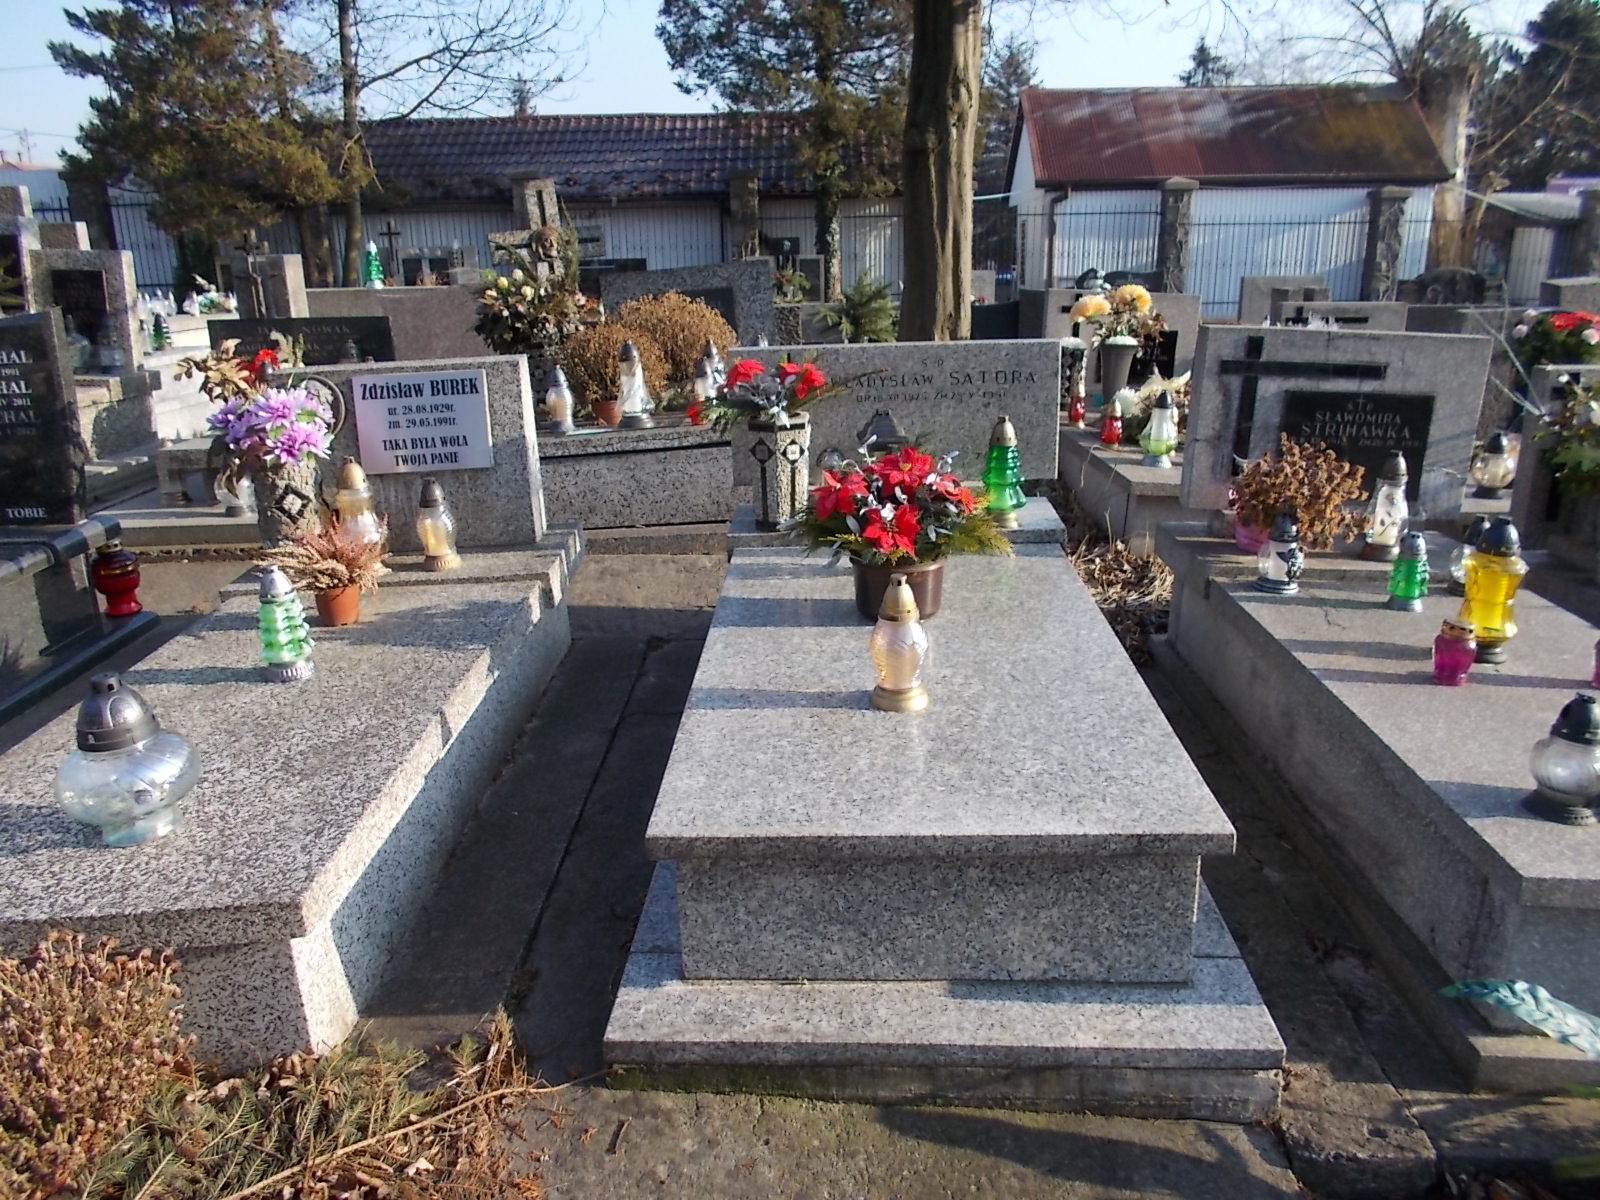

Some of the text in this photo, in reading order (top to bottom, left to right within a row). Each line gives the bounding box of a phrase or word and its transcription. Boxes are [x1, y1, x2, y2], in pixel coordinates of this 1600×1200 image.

[949, 370, 1036, 386] SATORA
[360, 378, 479, 400] Zdzisław BUREK
[387, 403, 456, 416] ur. 28.08.1929r.
[1315, 410, 1401, 424] SŁAWOMIRA
[405, 416, 458, 429] 29.05.1991r.
[1301, 422, 1411, 440] STRIHAWKA
[382, 438, 408, 452] TAKA
[411, 436, 437, 450] BYŁA
[394, 451, 459, 467] TWOJA PANIE
[6, 507, 47, 519] TOBIE
